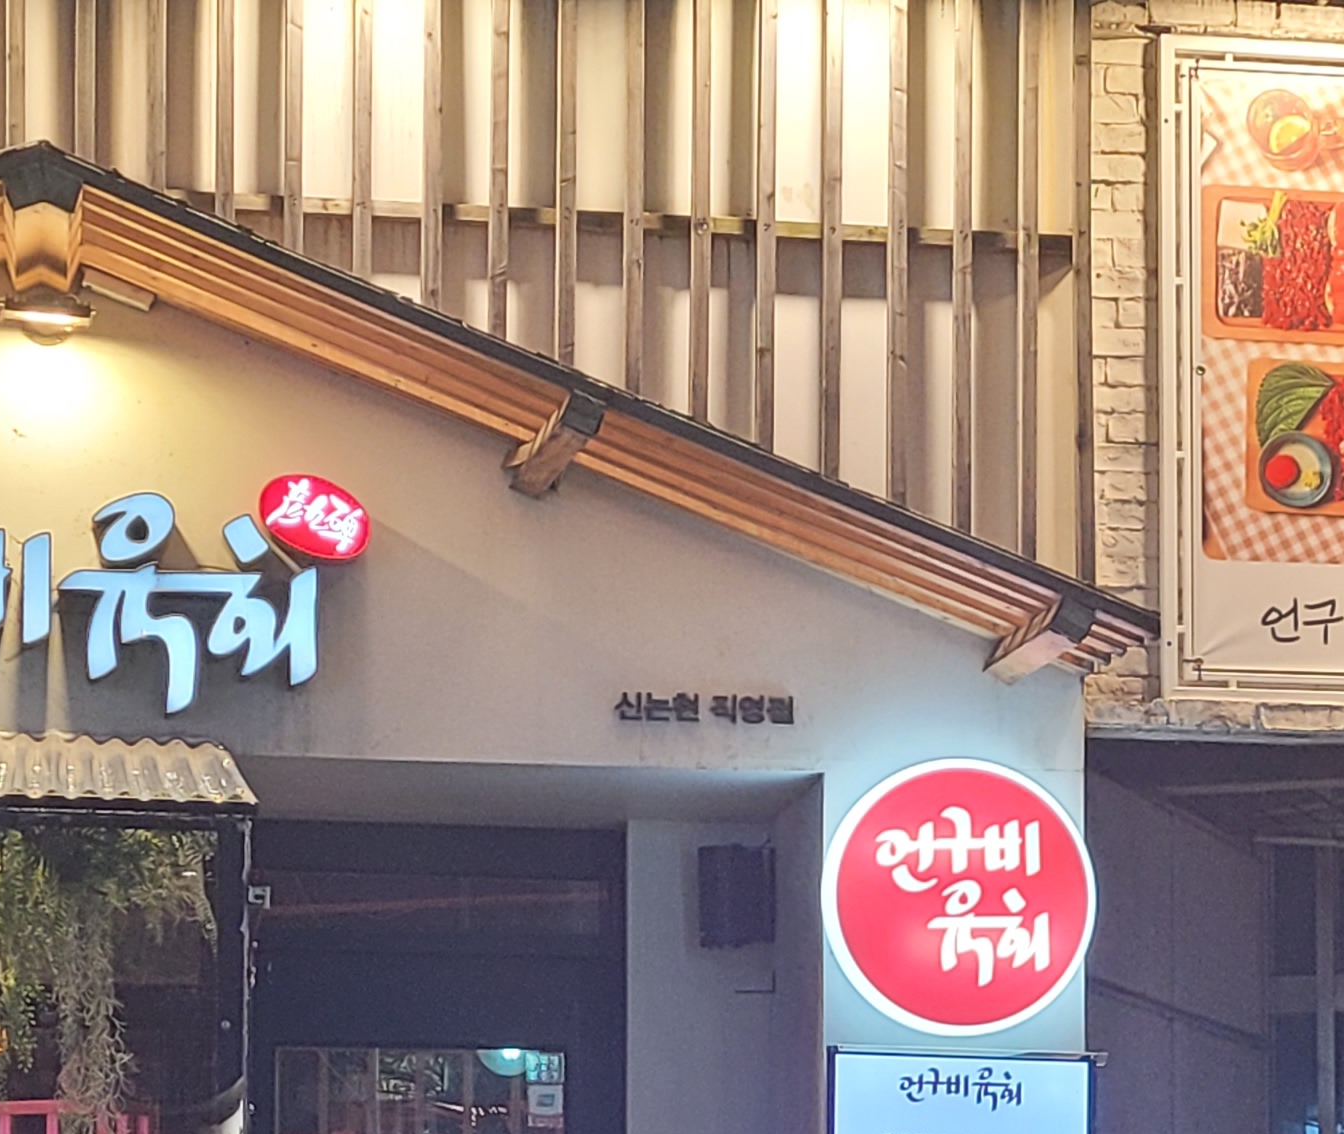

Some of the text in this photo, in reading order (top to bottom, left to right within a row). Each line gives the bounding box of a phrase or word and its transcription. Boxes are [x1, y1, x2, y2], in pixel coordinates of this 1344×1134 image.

[614, 692, 794, 724] 신논현 직영점
[876, 806, 1040, 892] 언구비
[927, 880, 1051, 987] 육회
[900, 1067, 1022, 1111] 언구비육회
